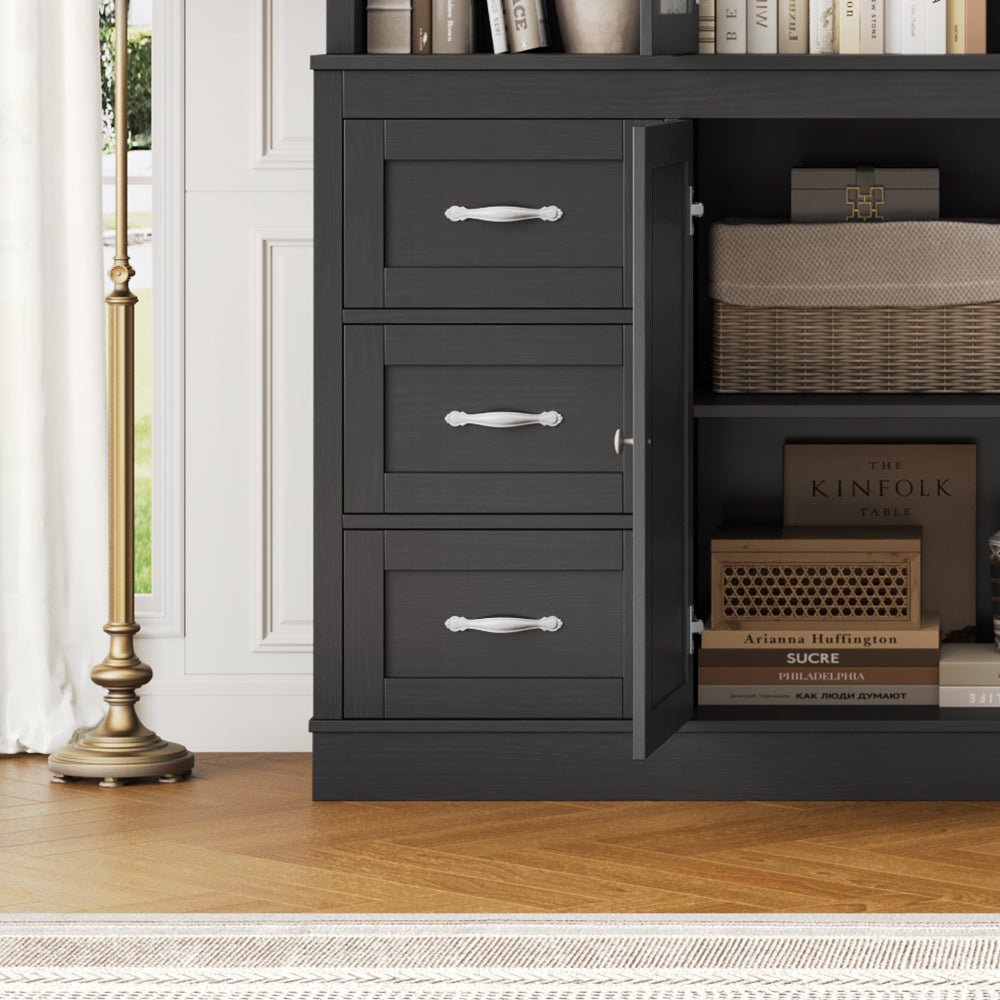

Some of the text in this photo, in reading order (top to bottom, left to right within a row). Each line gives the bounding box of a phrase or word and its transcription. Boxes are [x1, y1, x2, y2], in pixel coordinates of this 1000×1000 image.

[868, 461, 903, 470] THE
[811, 479, 952, 498] KINFOLK
[858, 508, 912, 517] TABLE
[744, 634, 898, 647] Arianna Huffington
[786, 652, 840, 664] SUCRE
[778, 672, 865, 681] PHILADELPHIA
[796, 692, 908, 701] КАК ЛЮДИ ДУМАЮТ
